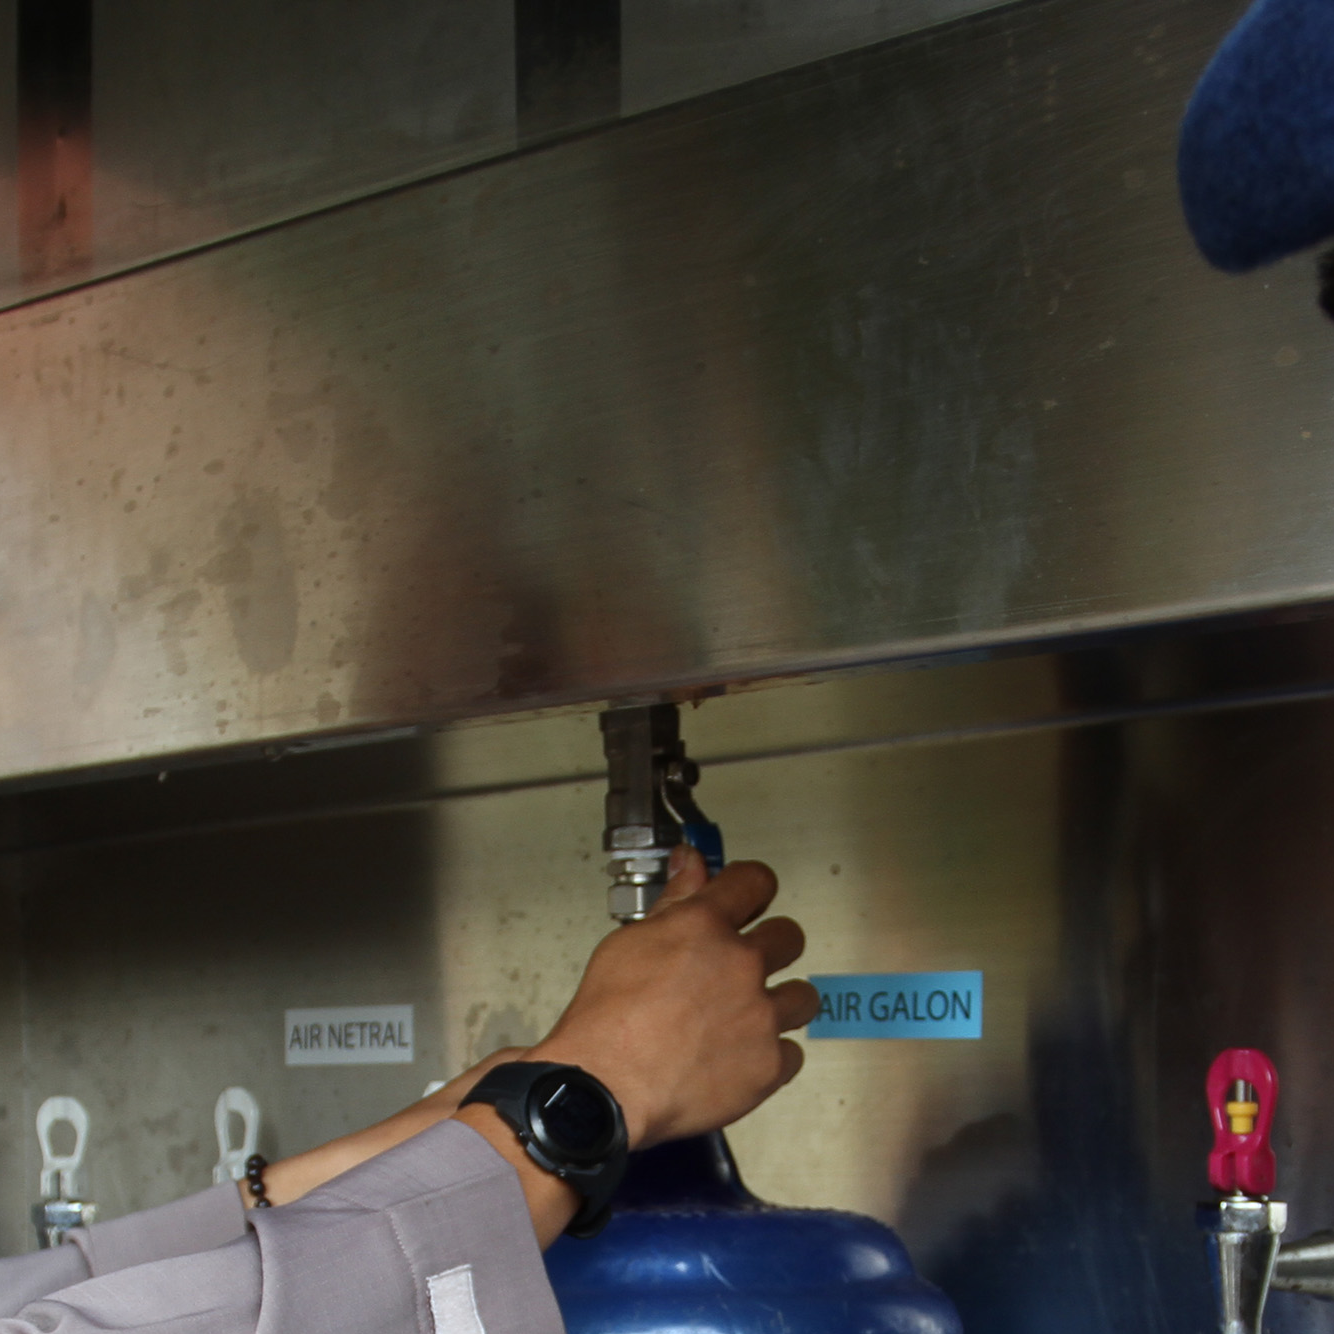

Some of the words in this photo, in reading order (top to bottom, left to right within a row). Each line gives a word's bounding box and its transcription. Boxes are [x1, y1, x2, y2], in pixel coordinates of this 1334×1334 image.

[817, 990, 861, 1022] AIR
[869, 989, 971, 1022] GALON
[290, 1023, 322, 1050] AIR
[328, 1020, 409, 1050] NETRAL
